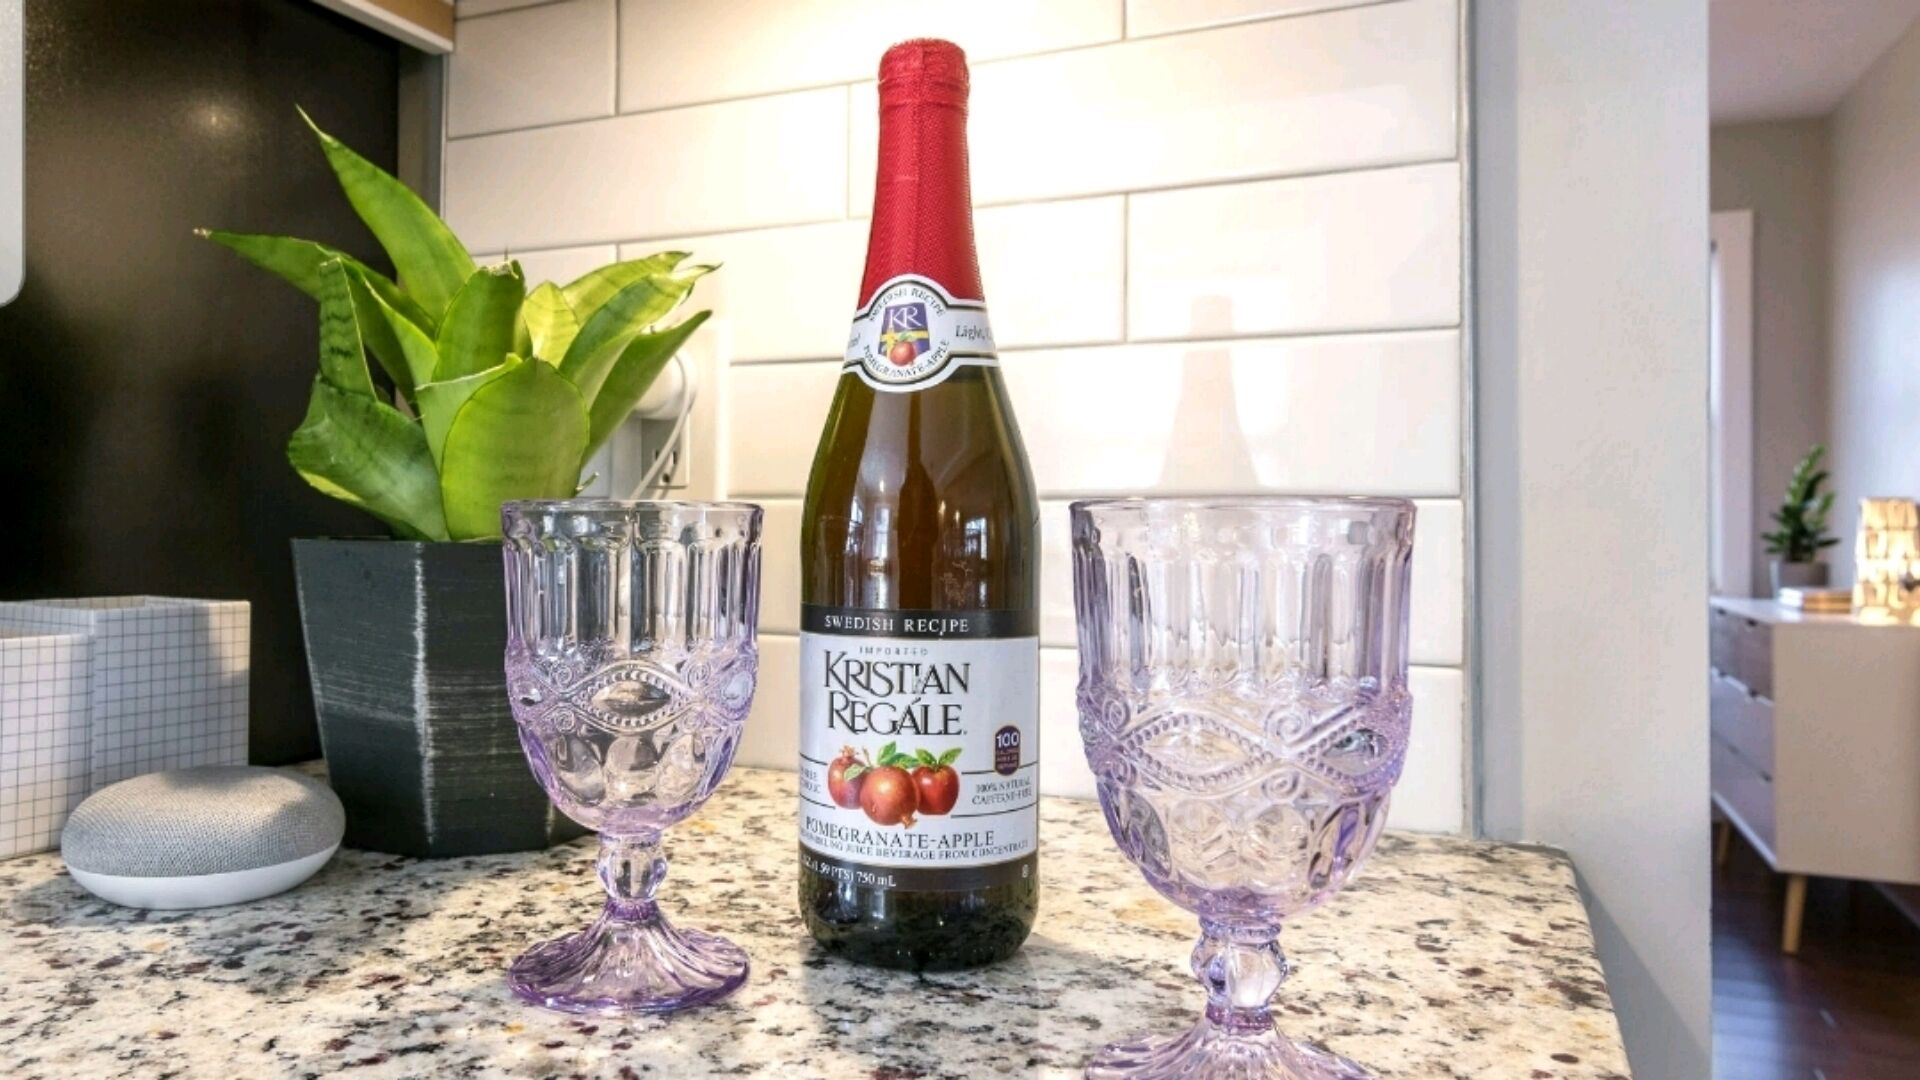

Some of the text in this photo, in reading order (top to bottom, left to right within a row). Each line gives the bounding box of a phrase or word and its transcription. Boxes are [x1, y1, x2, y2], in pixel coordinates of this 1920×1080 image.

[889, 305, 923, 330] KR
[824, 614, 969, 634] SWEDISH RECIPE
[859, 645, 929, 656] IMPORTED
[824, 649, 971, 698] KRISTIAN
[996, 732, 1019, 748] 100
[805, 815, 994, 850] POMEGRANATE-APPLE
[876, 846, 935, 860] BEVERAGE
[938, 850, 969, 860] FROM
[857, 871, 875, 885] 750
[877, 874, 897, 887] mL
